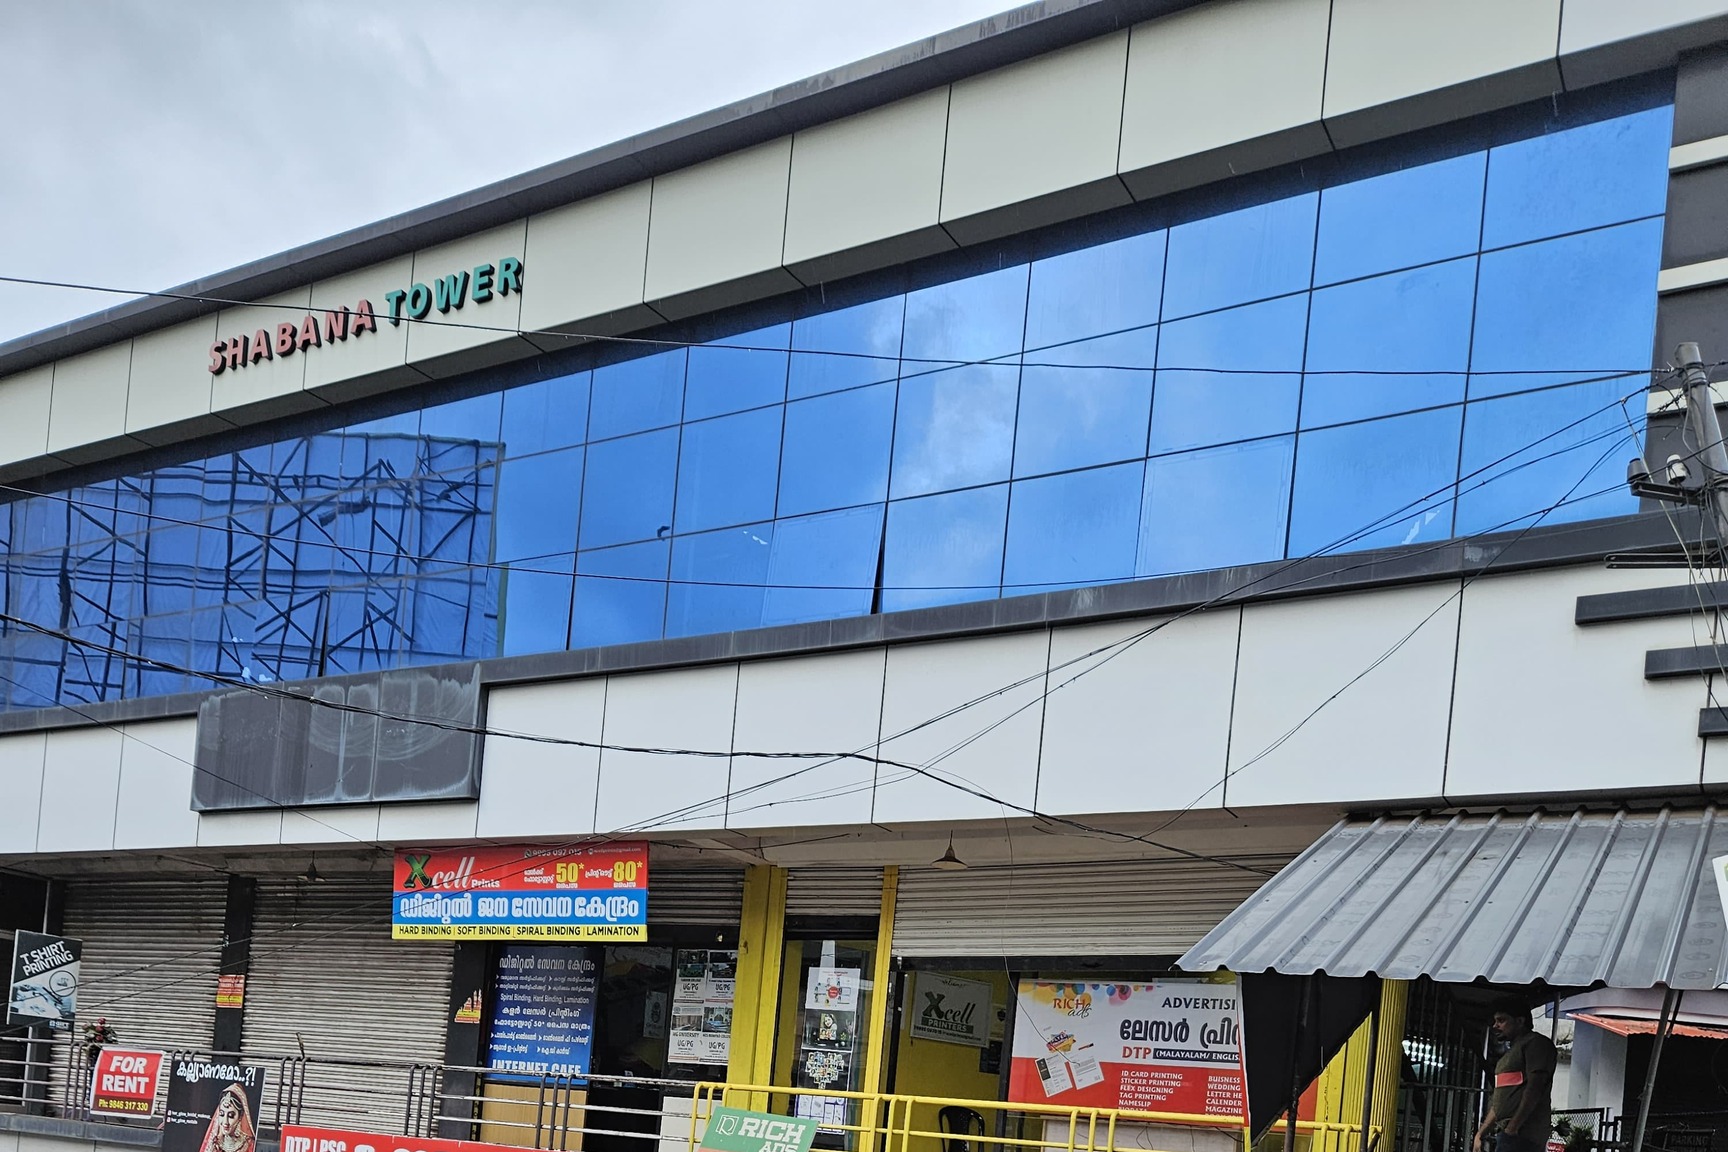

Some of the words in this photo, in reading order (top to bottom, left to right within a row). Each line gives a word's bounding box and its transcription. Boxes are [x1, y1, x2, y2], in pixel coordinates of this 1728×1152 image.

[208, 299, 377, 375] SHABANA
[385, 257, 522, 327] TOWER
[403, 854, 475, 889] Xcell
[471, 879, 500, 888] Prints
[400, 892, 472, 924] ഡിജിറ്റൽ
[477, 897, 509, 918] ജന
[511, 896, 572, 918] സേവന
[574, 896, 639, 922] കേന്ദ്രം
[399, 926, 419, 935] HARD
[421, 926, 452, 935] BINDING
[457, 925, 476, 935] SOFT
[478, 926, 511, 935] BINDING
[516, 926, 544, 936] SPIRAL
[546, 926, 581, 936] BINDING
[586, 926, 640, 936] LAMINATION
[20, 953, 29, 965] T
[30, 940, 65, 963] SHIRT
[22, 950, 74, 976] PRINTING
[922, 991, 976, 1025] Xcell
[1053, 998, 1086, 1009] RICH
[928, 1019, 967, 1032] PRINTERS
[1119, 1018, 1190, 1043] ലേസർ
[1122, 1045, 1152, 1059] DTP
[1156, 1050, 1210, 1060] (MALAYALAM/
[109, 1055, 147, 1074] FOR
[1130, 1070, 1149, 1078] CARD
[1150, 1072, 1183, 1080] PRINTING
[101, 1073, 150, 1094] RENT
[1120, 1077, 1147, 1085] STICKER
[1148, 1079, 1181, 1087] PRINTING
[1207, 1083, 1241, 1091] WEDDING
[1137, 1086, 1174, 1094] DESIGNING
[1118, 1099, 1151, 1107] NAMESLIP
[1134, 1093, 1167, 1101] PRINTING
[1205, 1098, 1243, 1107] CALENDER
[124, 1100, 136, 1110] 317
[1205, 1106, 1243, 1114] MAGAZINE
[738, 1117, 806, 1144] RICH
